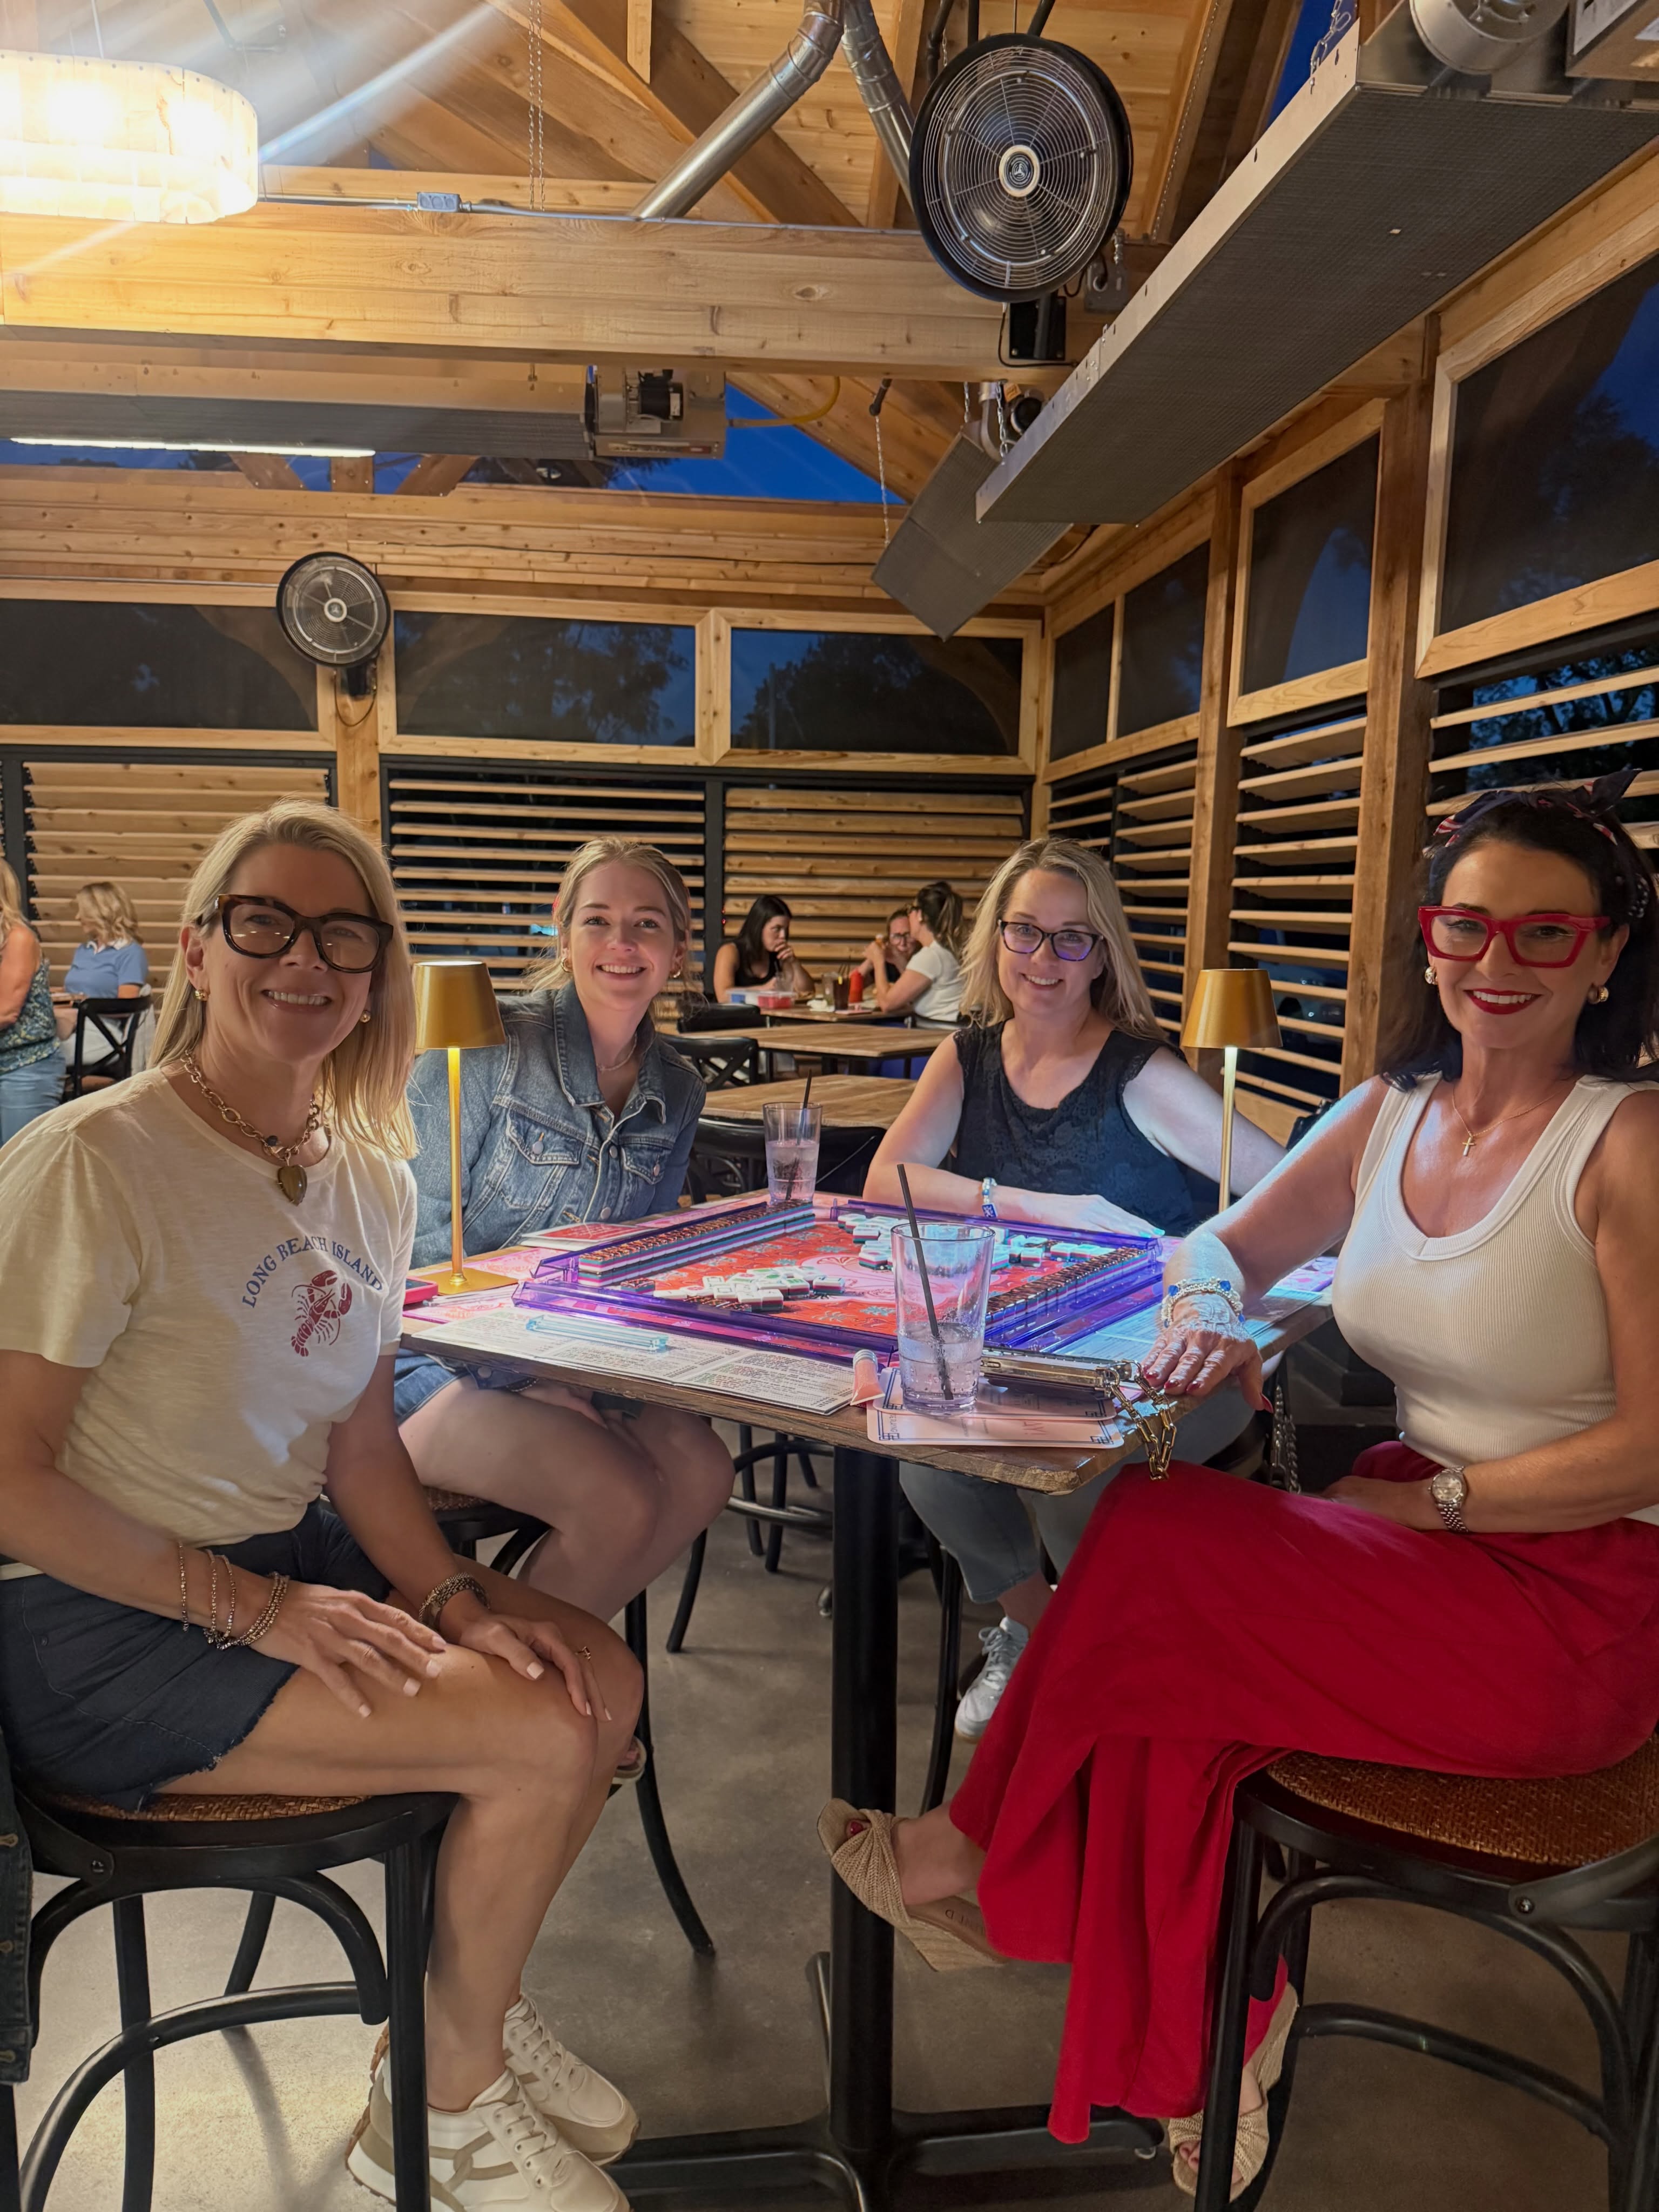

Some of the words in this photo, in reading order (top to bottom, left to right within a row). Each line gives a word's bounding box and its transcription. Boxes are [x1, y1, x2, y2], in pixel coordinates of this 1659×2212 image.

[242, 1255, 276, 1308] LONG
[276, 1236, 328, 1261] BEACH
[332, 1241, 383, 1291] ISLAND
